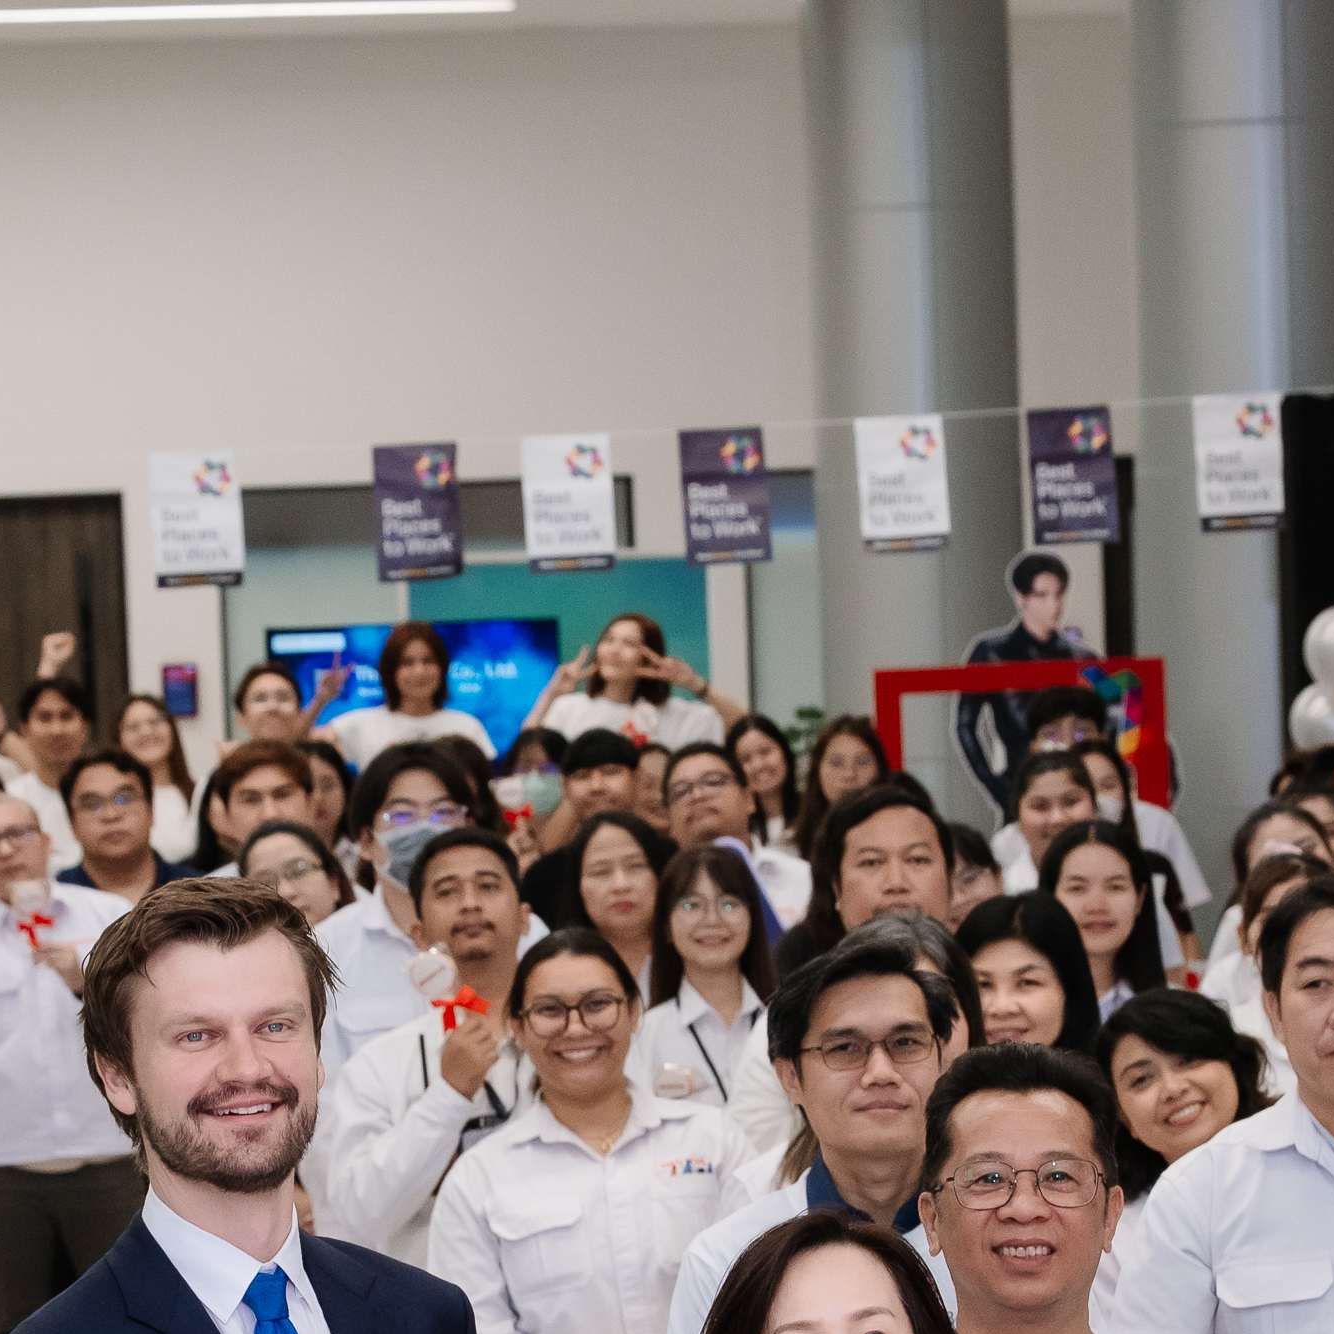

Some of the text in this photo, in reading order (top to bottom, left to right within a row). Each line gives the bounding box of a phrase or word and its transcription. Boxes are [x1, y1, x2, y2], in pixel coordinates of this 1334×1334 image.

[1035, 462, 1074, 480] Best
[687, 482, 727, 500] Best
[1036, 481, 1095, 500] Places
[381, 498, 421, 517] Best
[688, 501, 748, 518] Places
[1037, 502, 1059, 520] to
[382, 517, 442, 537] Places
[690, 522, 712, 540] to
[383, 539, 405, 558] to
